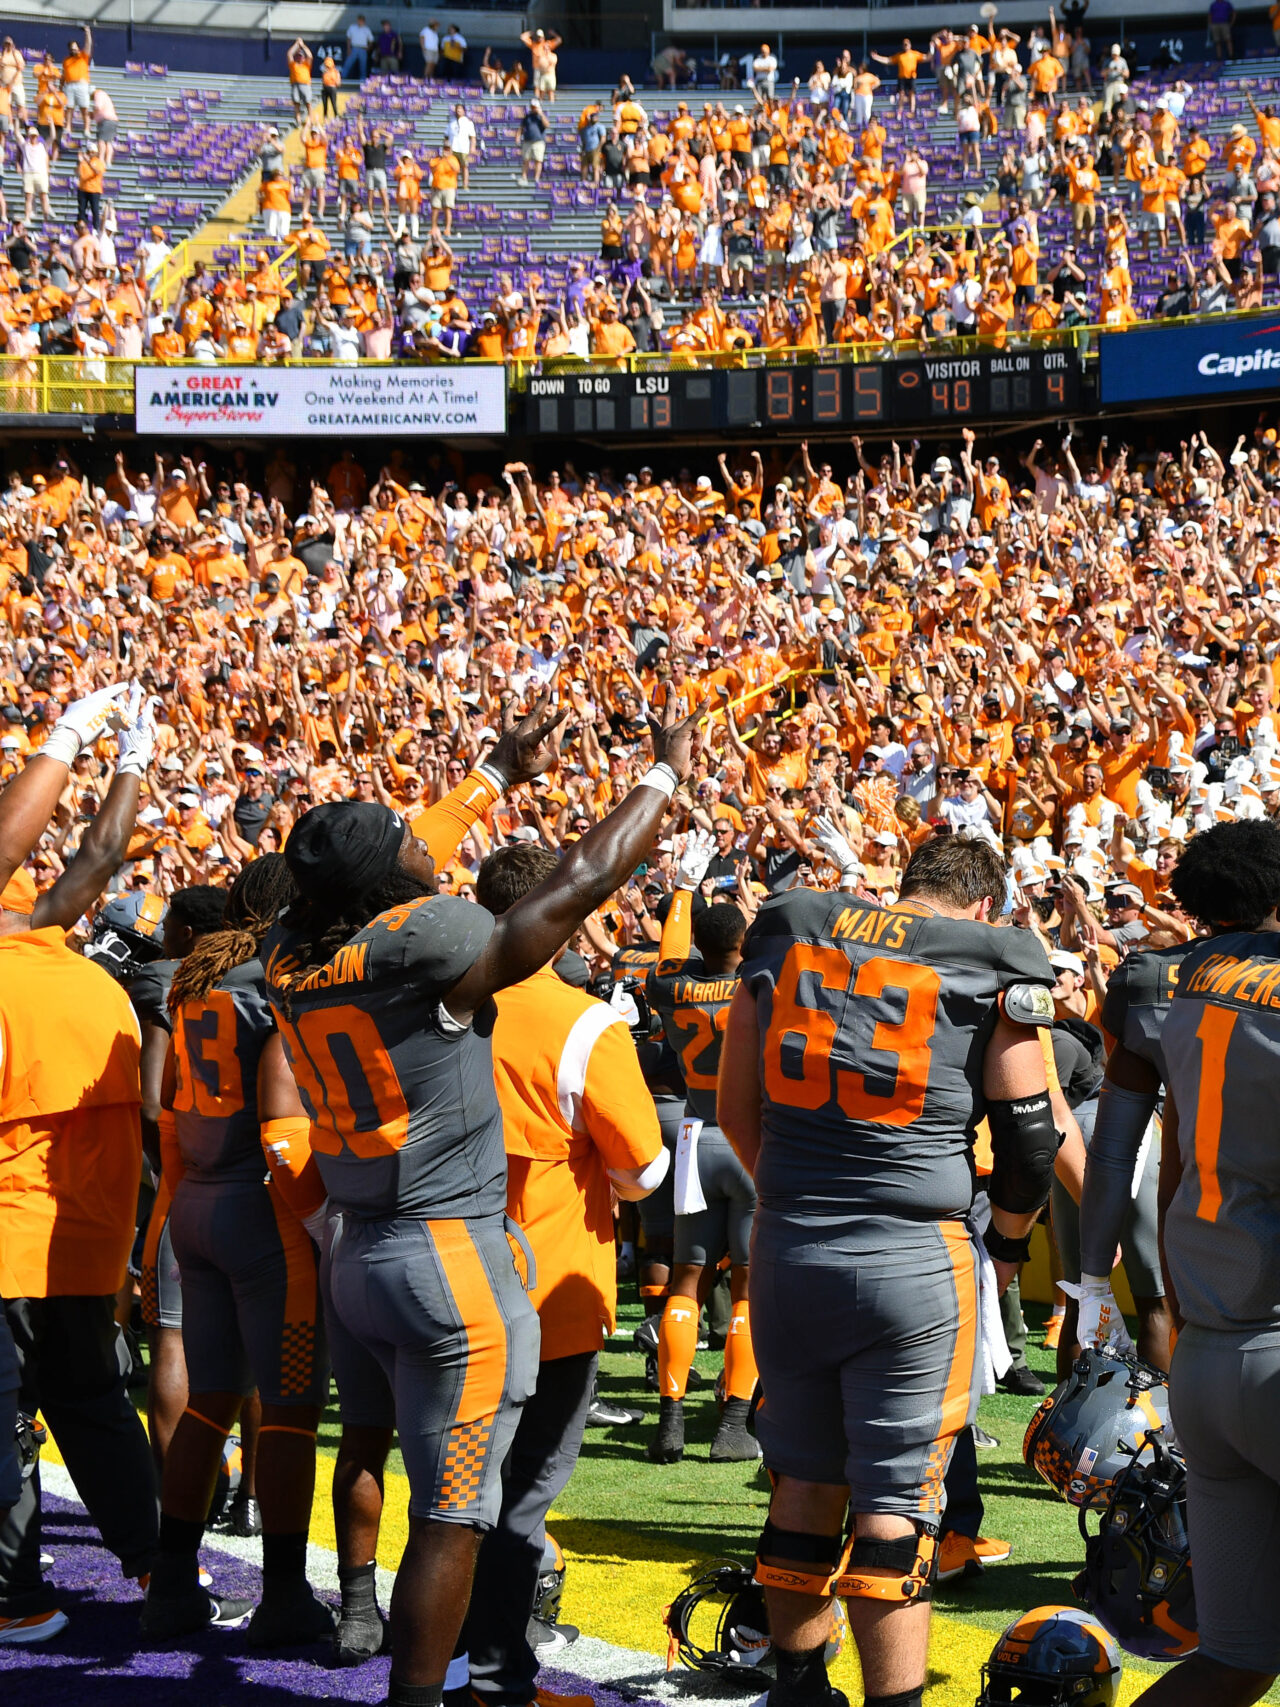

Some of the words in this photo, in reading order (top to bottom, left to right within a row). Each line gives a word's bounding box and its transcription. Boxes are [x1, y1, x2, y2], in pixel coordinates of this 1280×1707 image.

[925, 360, 980, 380] VISITOR
[990, 358, 1014, 373] BALL
[1016, 357, 1030, 371] ON
[186, 376, 243, 390] GREAT
[329, 374, 381, 391] Making
[386, 374, 454, 388] Memories
[531, 379, 565, 395] DOWN
[577, 378, 592, 394] TO
[594, 377, 610, 393] GO
[635, 376, 669, 394] LSU
[1047, 375, 1064, 402] 4
[150, 391, 249, 407] AMERICAN
[253, 392, 279, 407] RV
[304, 391, 335, 406] One
[338, 391, 404, 405] Weekend
[408, 391, 424, 404] At
[427, 391, 439, 404] A
[442, 390, 479, 404] Time!
[932, 380, 970, 411] 40
[307, 412, 477, 426] GREATAMERICANRV.COM
[642, 395, 671, 426] 13
[831, 908, 913, 949] MAYS
[764, 942, 941, 1126] 63
[1194, 1004, 1238, 1223] 1
